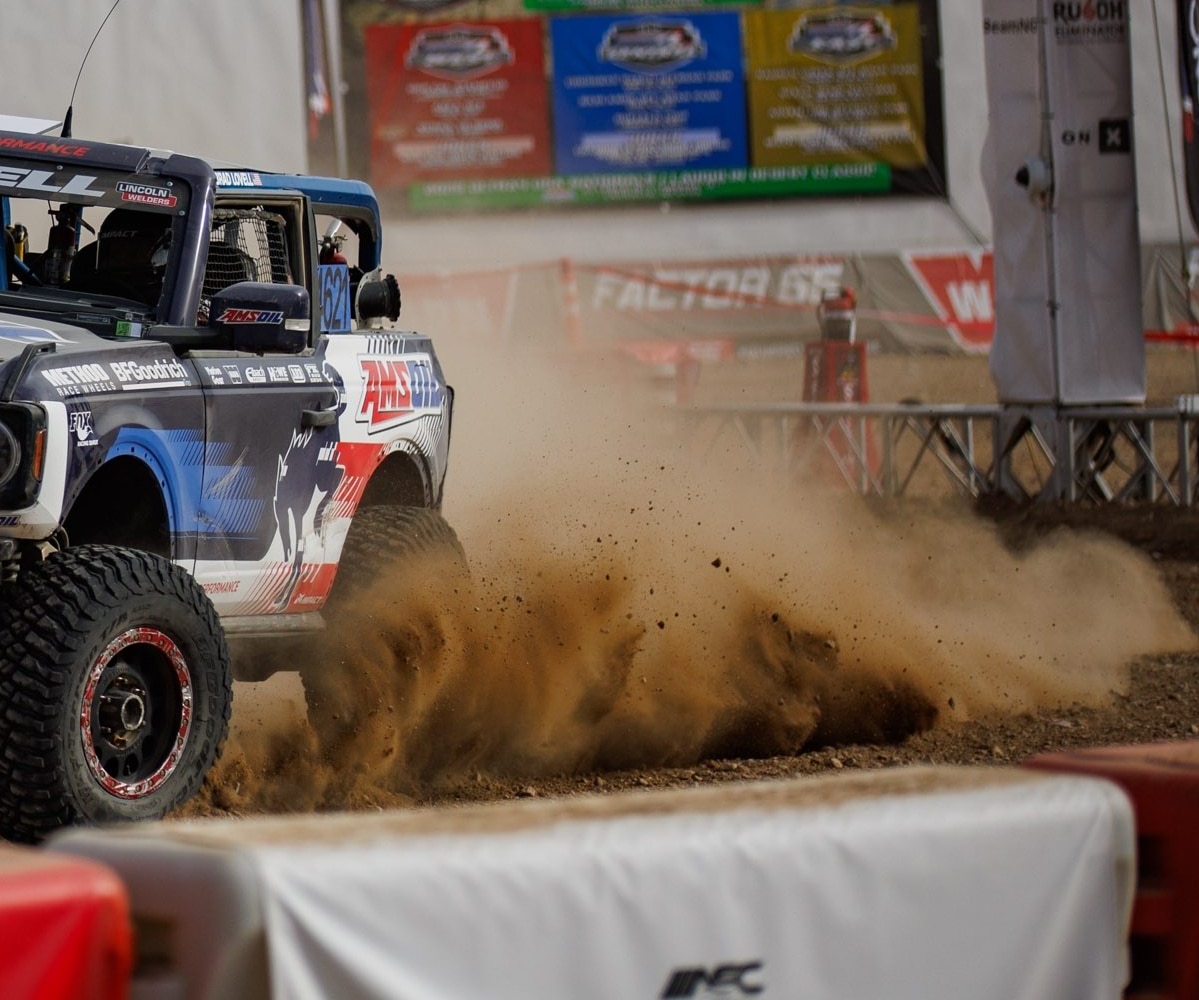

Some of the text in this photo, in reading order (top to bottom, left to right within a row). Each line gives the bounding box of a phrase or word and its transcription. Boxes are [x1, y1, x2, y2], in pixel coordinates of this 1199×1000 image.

[118, 184, 170, 198] LINCOLN
[126, 195, 174, 206] WELDERS
[318, 266, 349, 330] 621
[595, 267, 772, 311] FACTOR
[220, 308, 284, 324] AMSOIL
[41, 357, 189, 387] METHOD BFGoodrich
[56, 381, 117, 397] RACE WHEELS
[361, 359, 443, 426] AMSOIL
[70, 411, 93, 433] FOX
